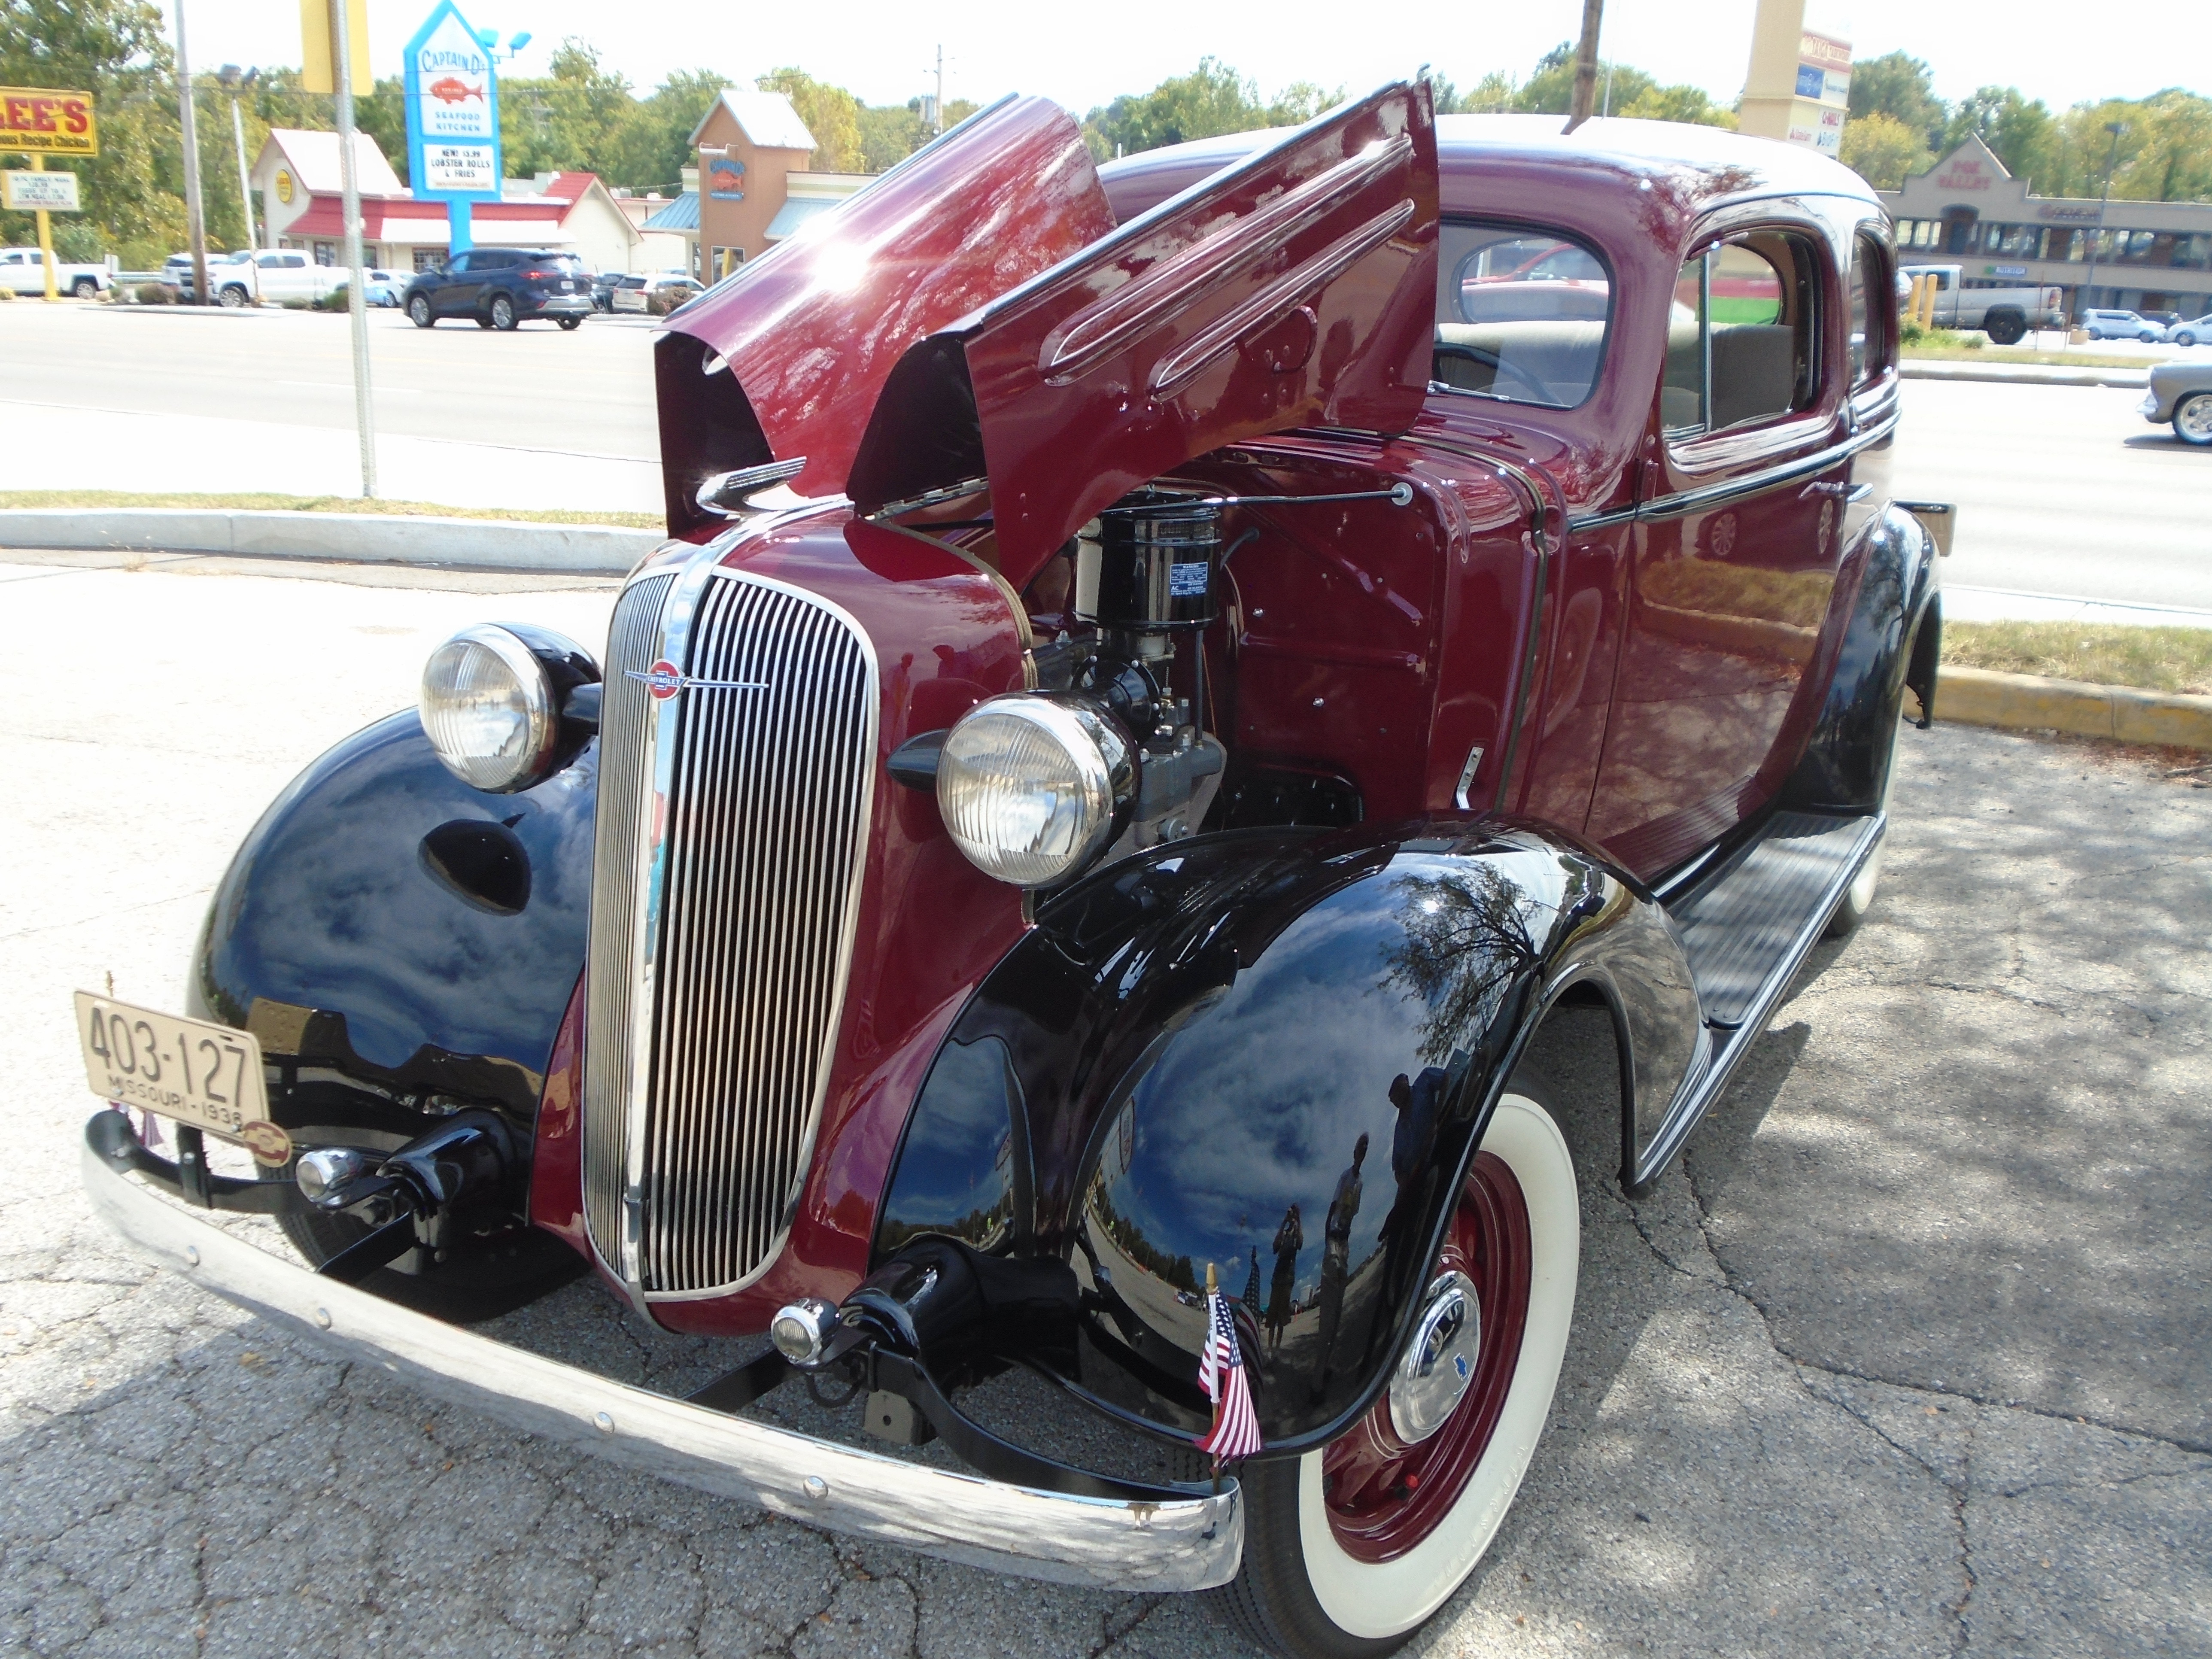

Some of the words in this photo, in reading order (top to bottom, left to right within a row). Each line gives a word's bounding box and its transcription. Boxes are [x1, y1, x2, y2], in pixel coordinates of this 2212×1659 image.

[422, 50, 468, 72] CAPTAIN
[0, 97, 87, 133] EE'S
[435, 112, 480, 120] SEAFOOD
[436, 123, 480, 131] KITCHEN
[431, 158, 463, 167] LOBSTER
[467, 159, 490, 167] ROLLS
[455, 169, 475, 177] FRIES
[648, 676, 680, 685] CHEVROLET
[91, 1008, 245, 1107] 403-127
